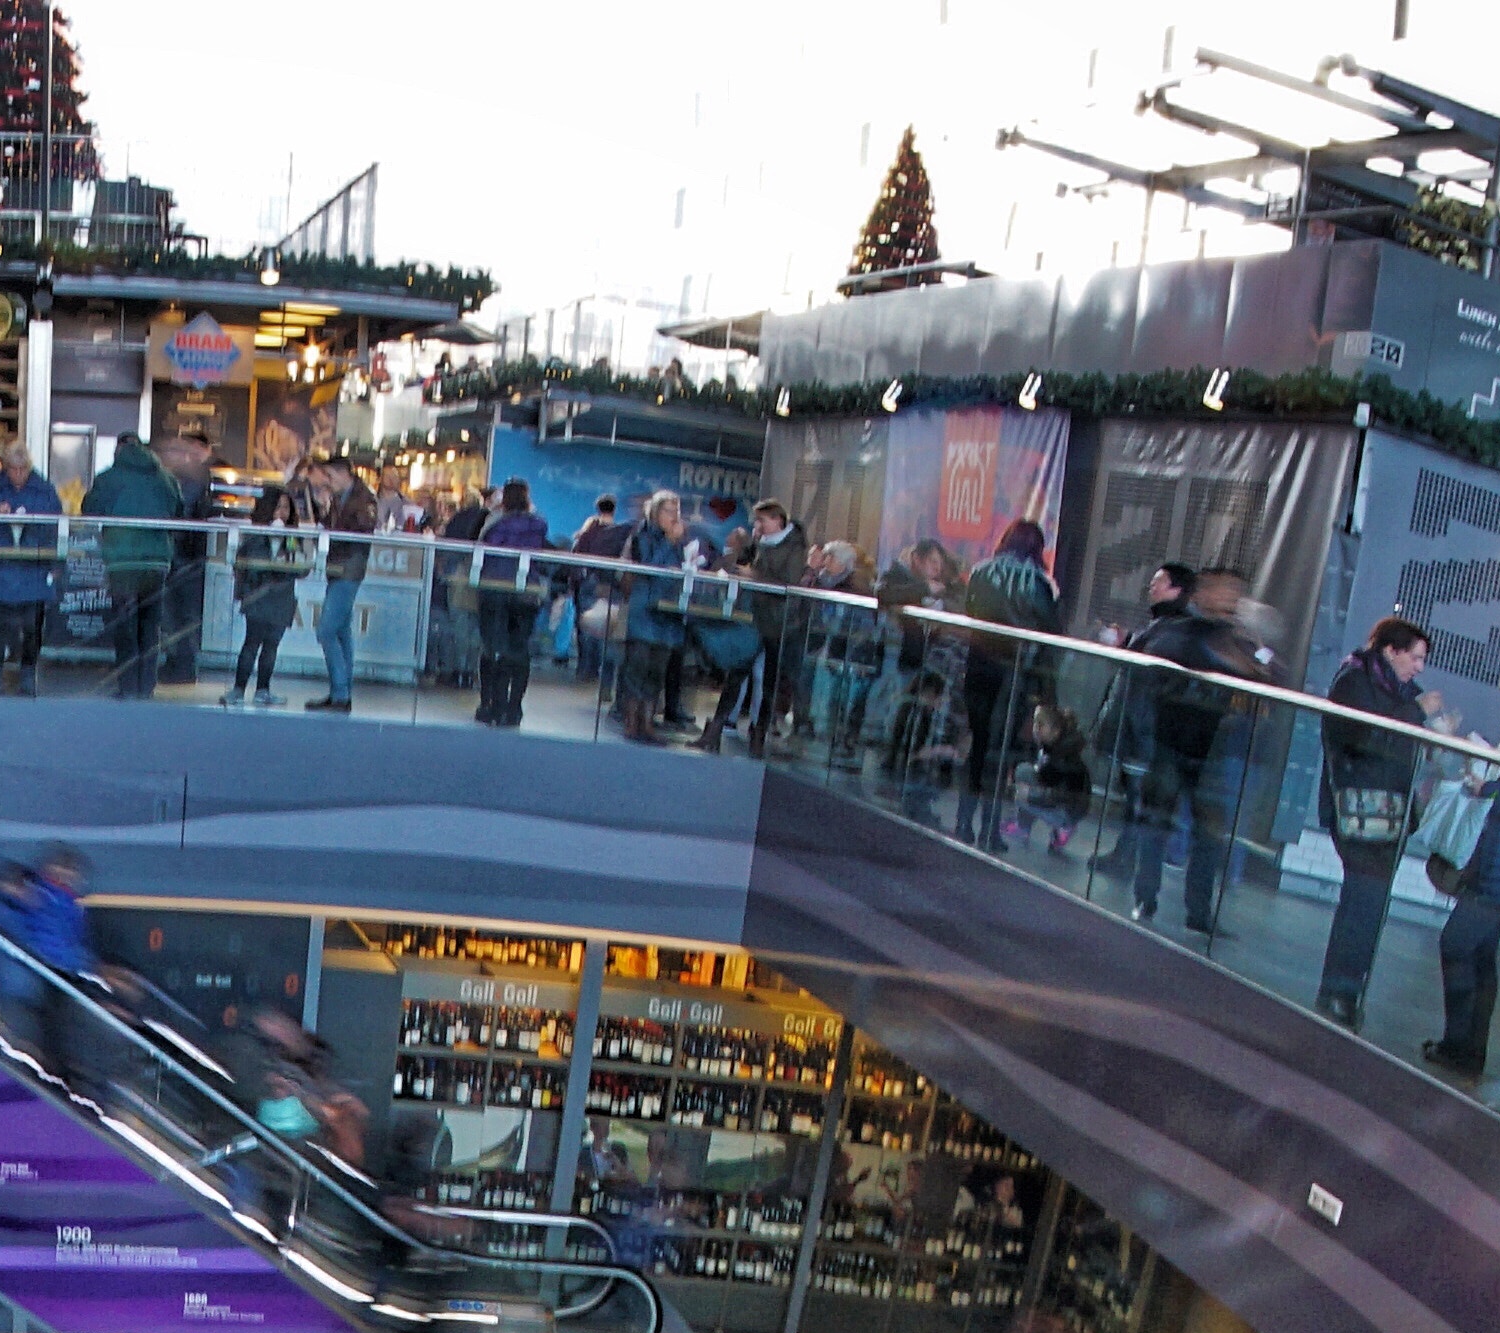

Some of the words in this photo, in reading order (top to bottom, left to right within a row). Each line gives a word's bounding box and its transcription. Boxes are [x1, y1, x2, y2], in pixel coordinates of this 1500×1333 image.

[460, 979, 495, 1004] Gall
[503, 981, 538, 1007] Gall
[648, 997, 682, 1023] Gall
[690, 1001, 723, 1027] Gall
[784, 1012, 816, 1038] Gall
[56, 1225, 91, 1242] 1900
